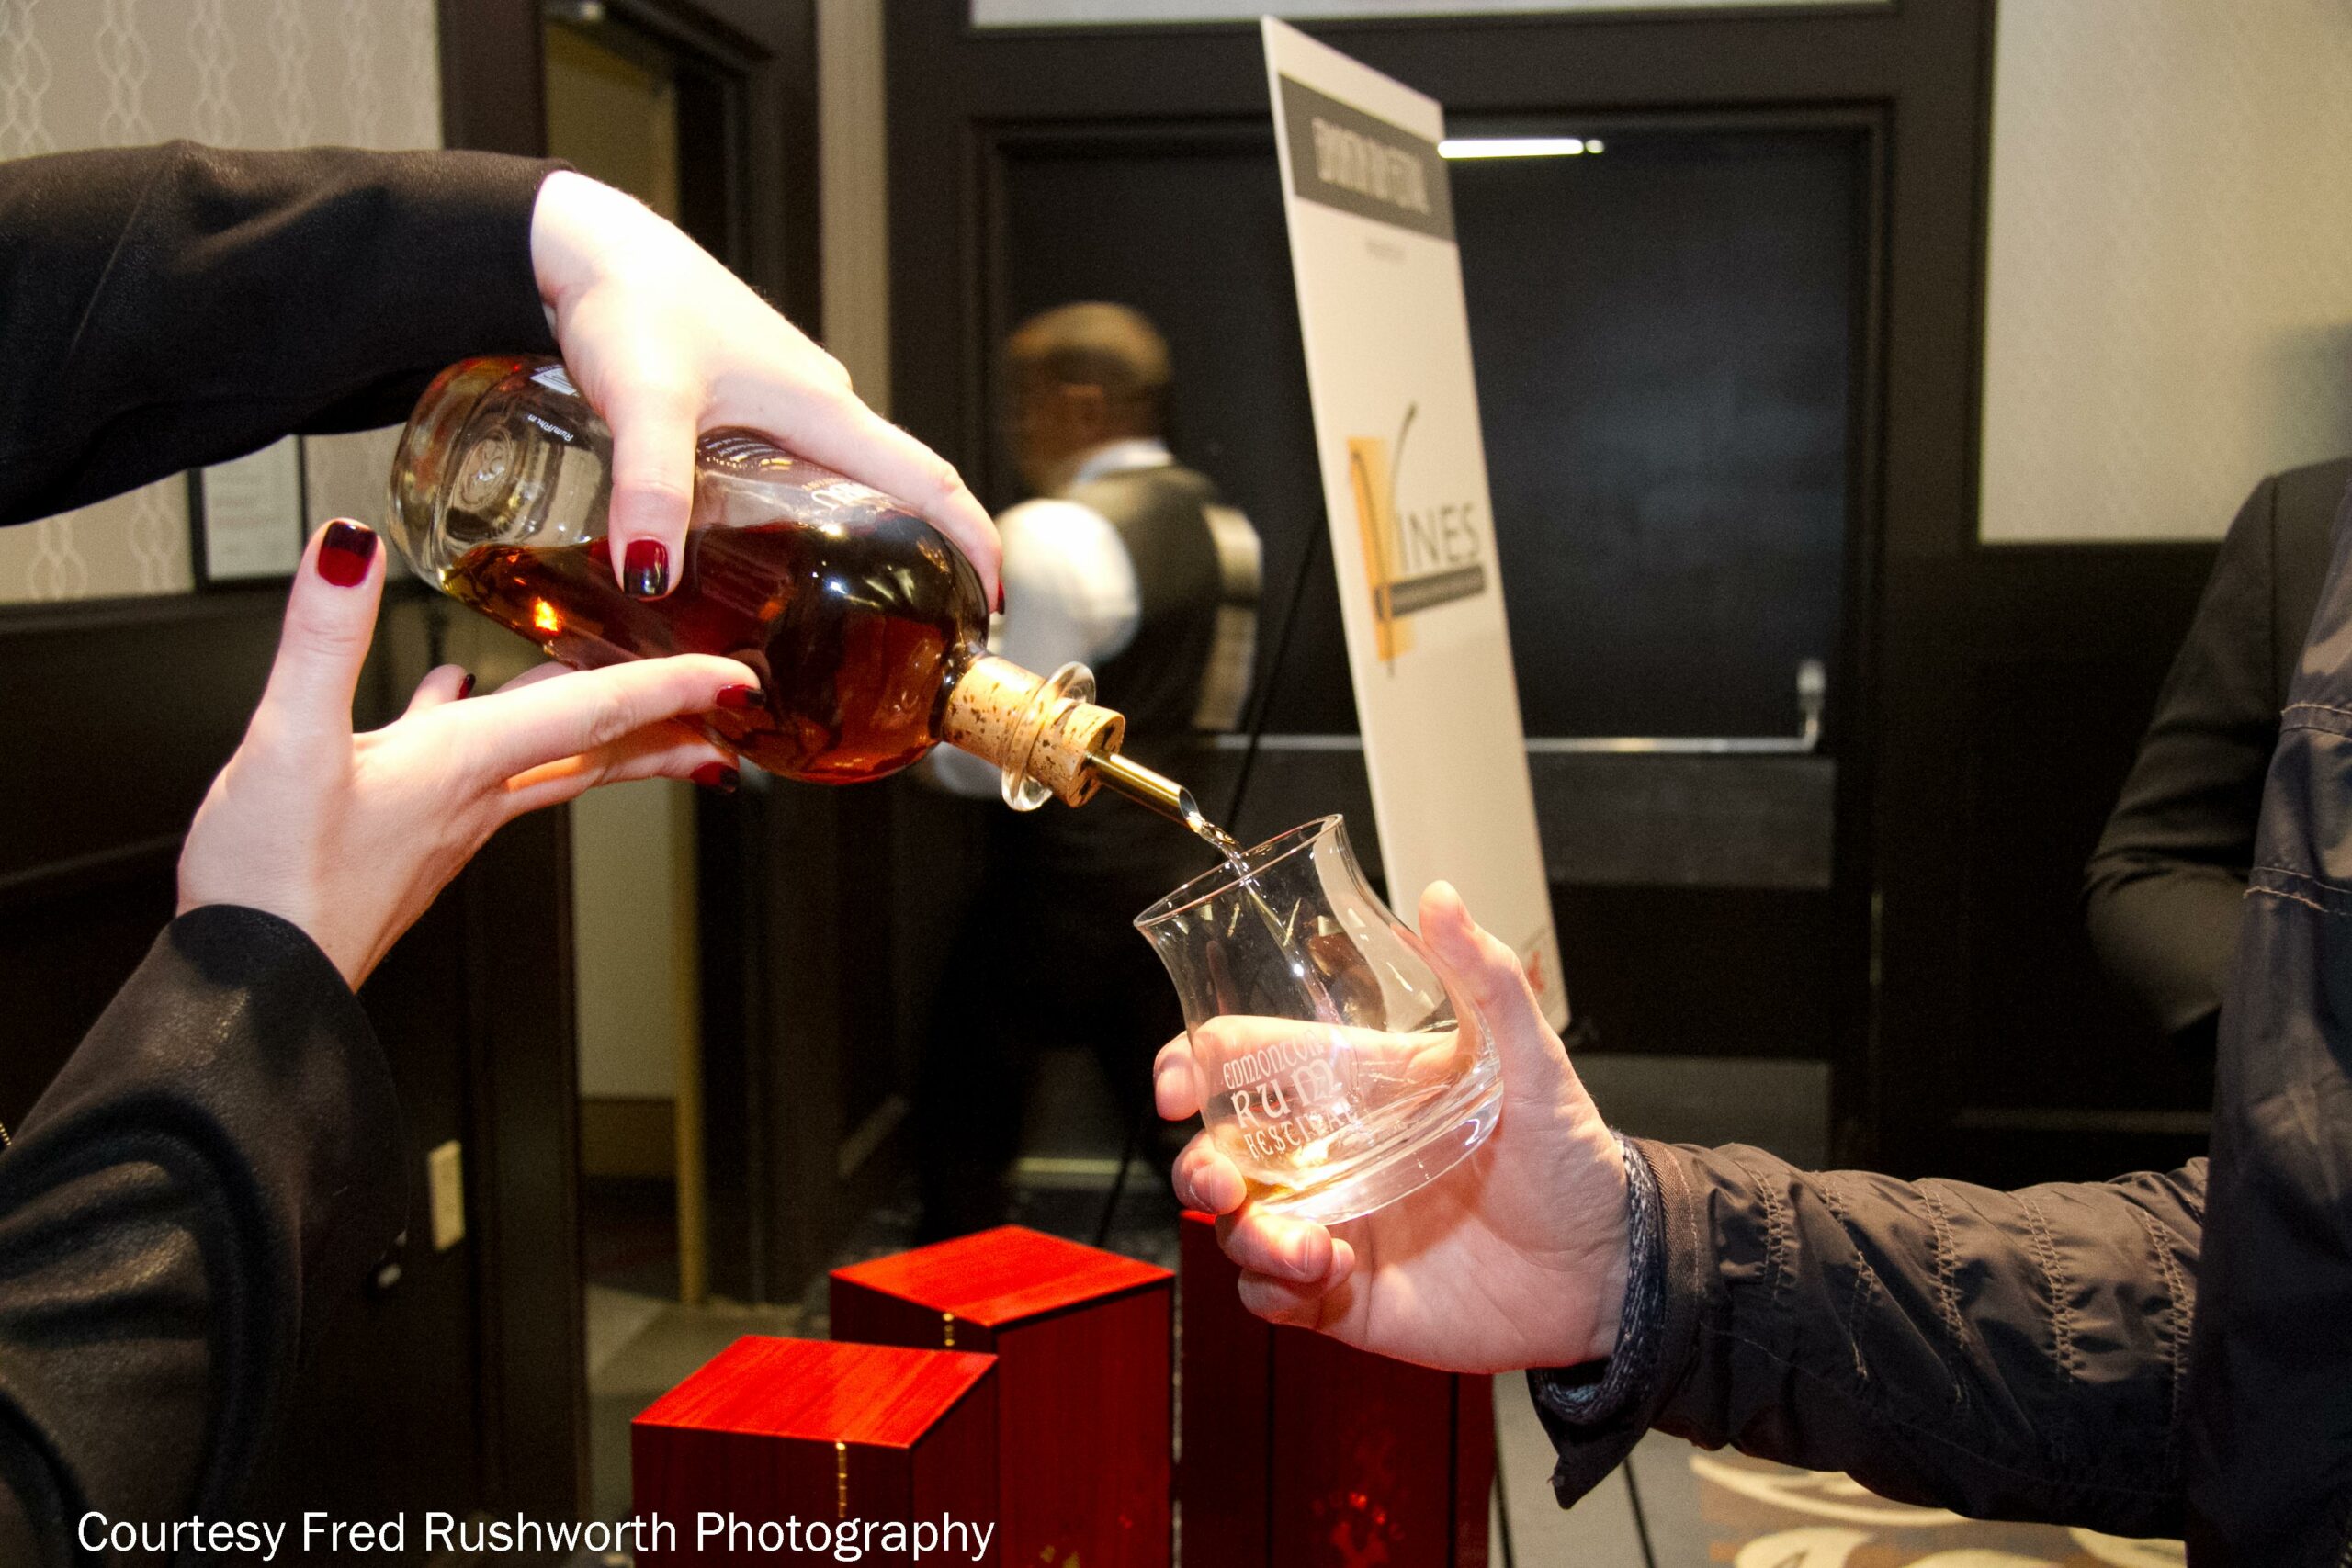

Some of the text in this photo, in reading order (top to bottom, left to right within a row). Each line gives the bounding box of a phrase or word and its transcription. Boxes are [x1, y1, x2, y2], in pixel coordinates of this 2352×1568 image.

[1222, 1030, 1326, 1090] EDMONTON
[1230, 1057, 1340, 1130] RUM
[1243, 1096, 1360, 1160] FESTIVAL
